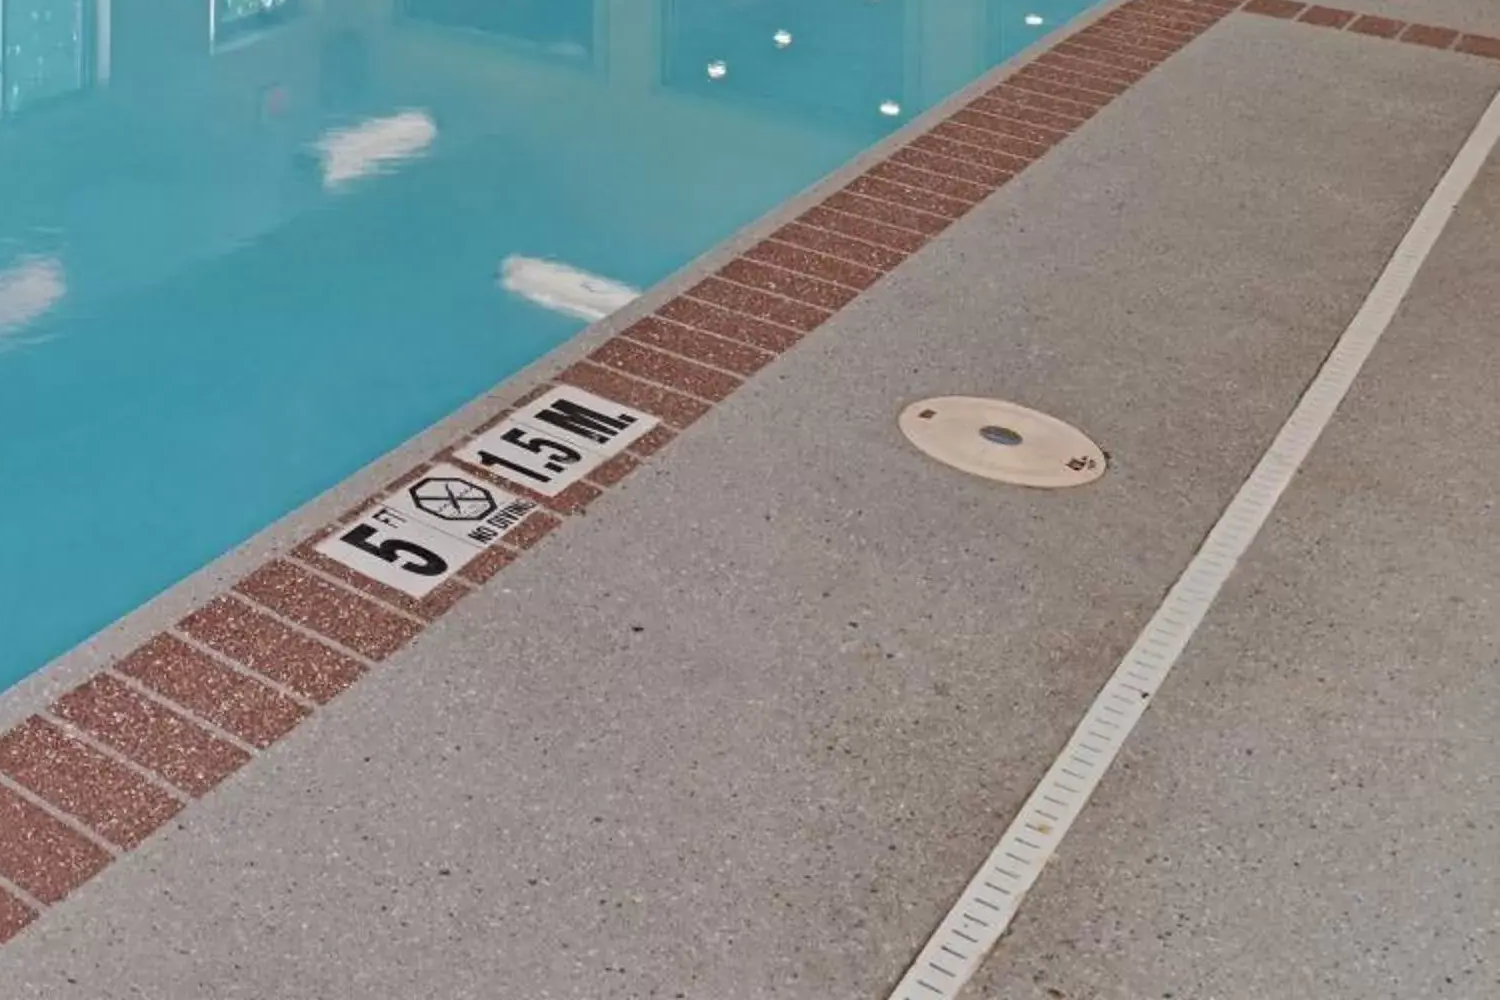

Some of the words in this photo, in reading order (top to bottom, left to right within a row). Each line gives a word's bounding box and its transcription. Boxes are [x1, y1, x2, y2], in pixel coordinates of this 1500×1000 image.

[477, 427, 582, 483] 1.5
[372, 508, 407, 529] FT
[467, 525, 499, 544] NO
[486, 500, 538, 531] DIVING
[339, 524, 449, 577] 5
